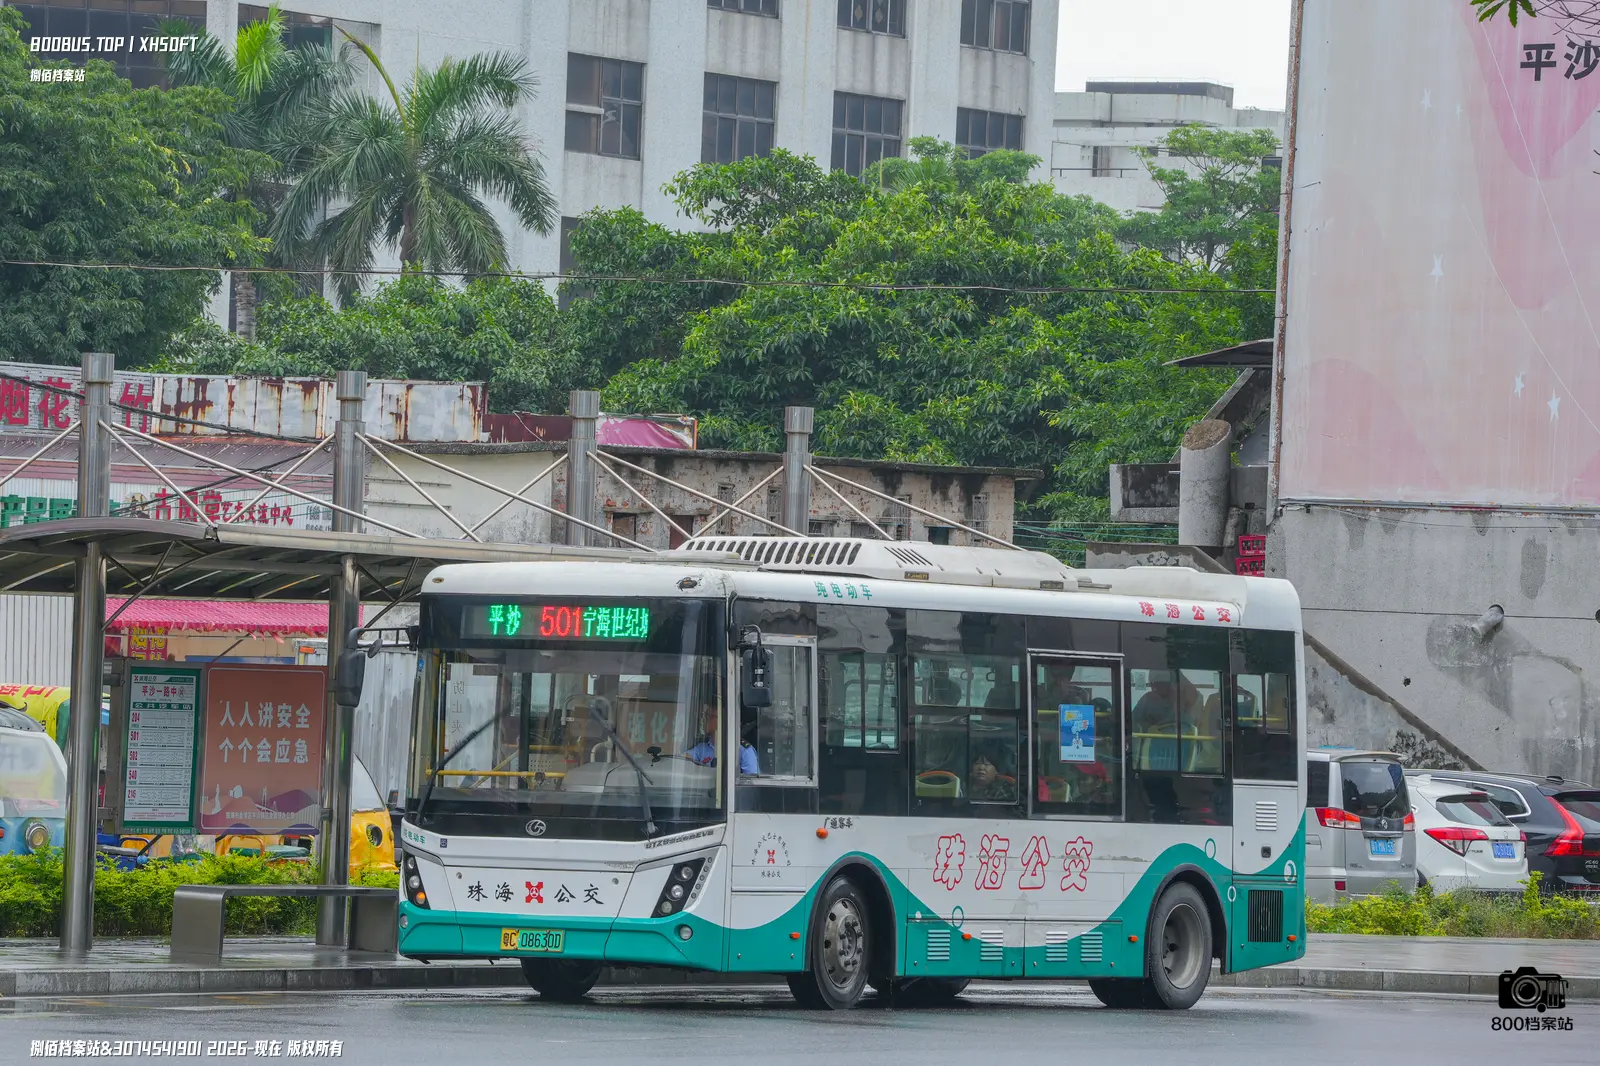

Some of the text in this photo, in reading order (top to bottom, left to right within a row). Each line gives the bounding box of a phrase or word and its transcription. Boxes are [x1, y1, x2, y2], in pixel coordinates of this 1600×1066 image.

[1520, 41, 1600, 81] 平沙
[0, 376, 153, 434] 烟花竹
[814, 581, 872, 600] 纯电动车
[489, 605, 521, 636] 平沙
[540, 607, 581, 637] 501
[1138, 602, 1231, 622] 珠海公交
[142, 685, 177, 697] 平沙一路中
[220, 701, 311, 729] 人人讲安全
[130, 731, 139, 740] 501
[219, 737, 309, 764] 个个会应急
[932, 833, 1094, 892] 珠海公交
[468, 881, 605, 905] 珠海 公交
